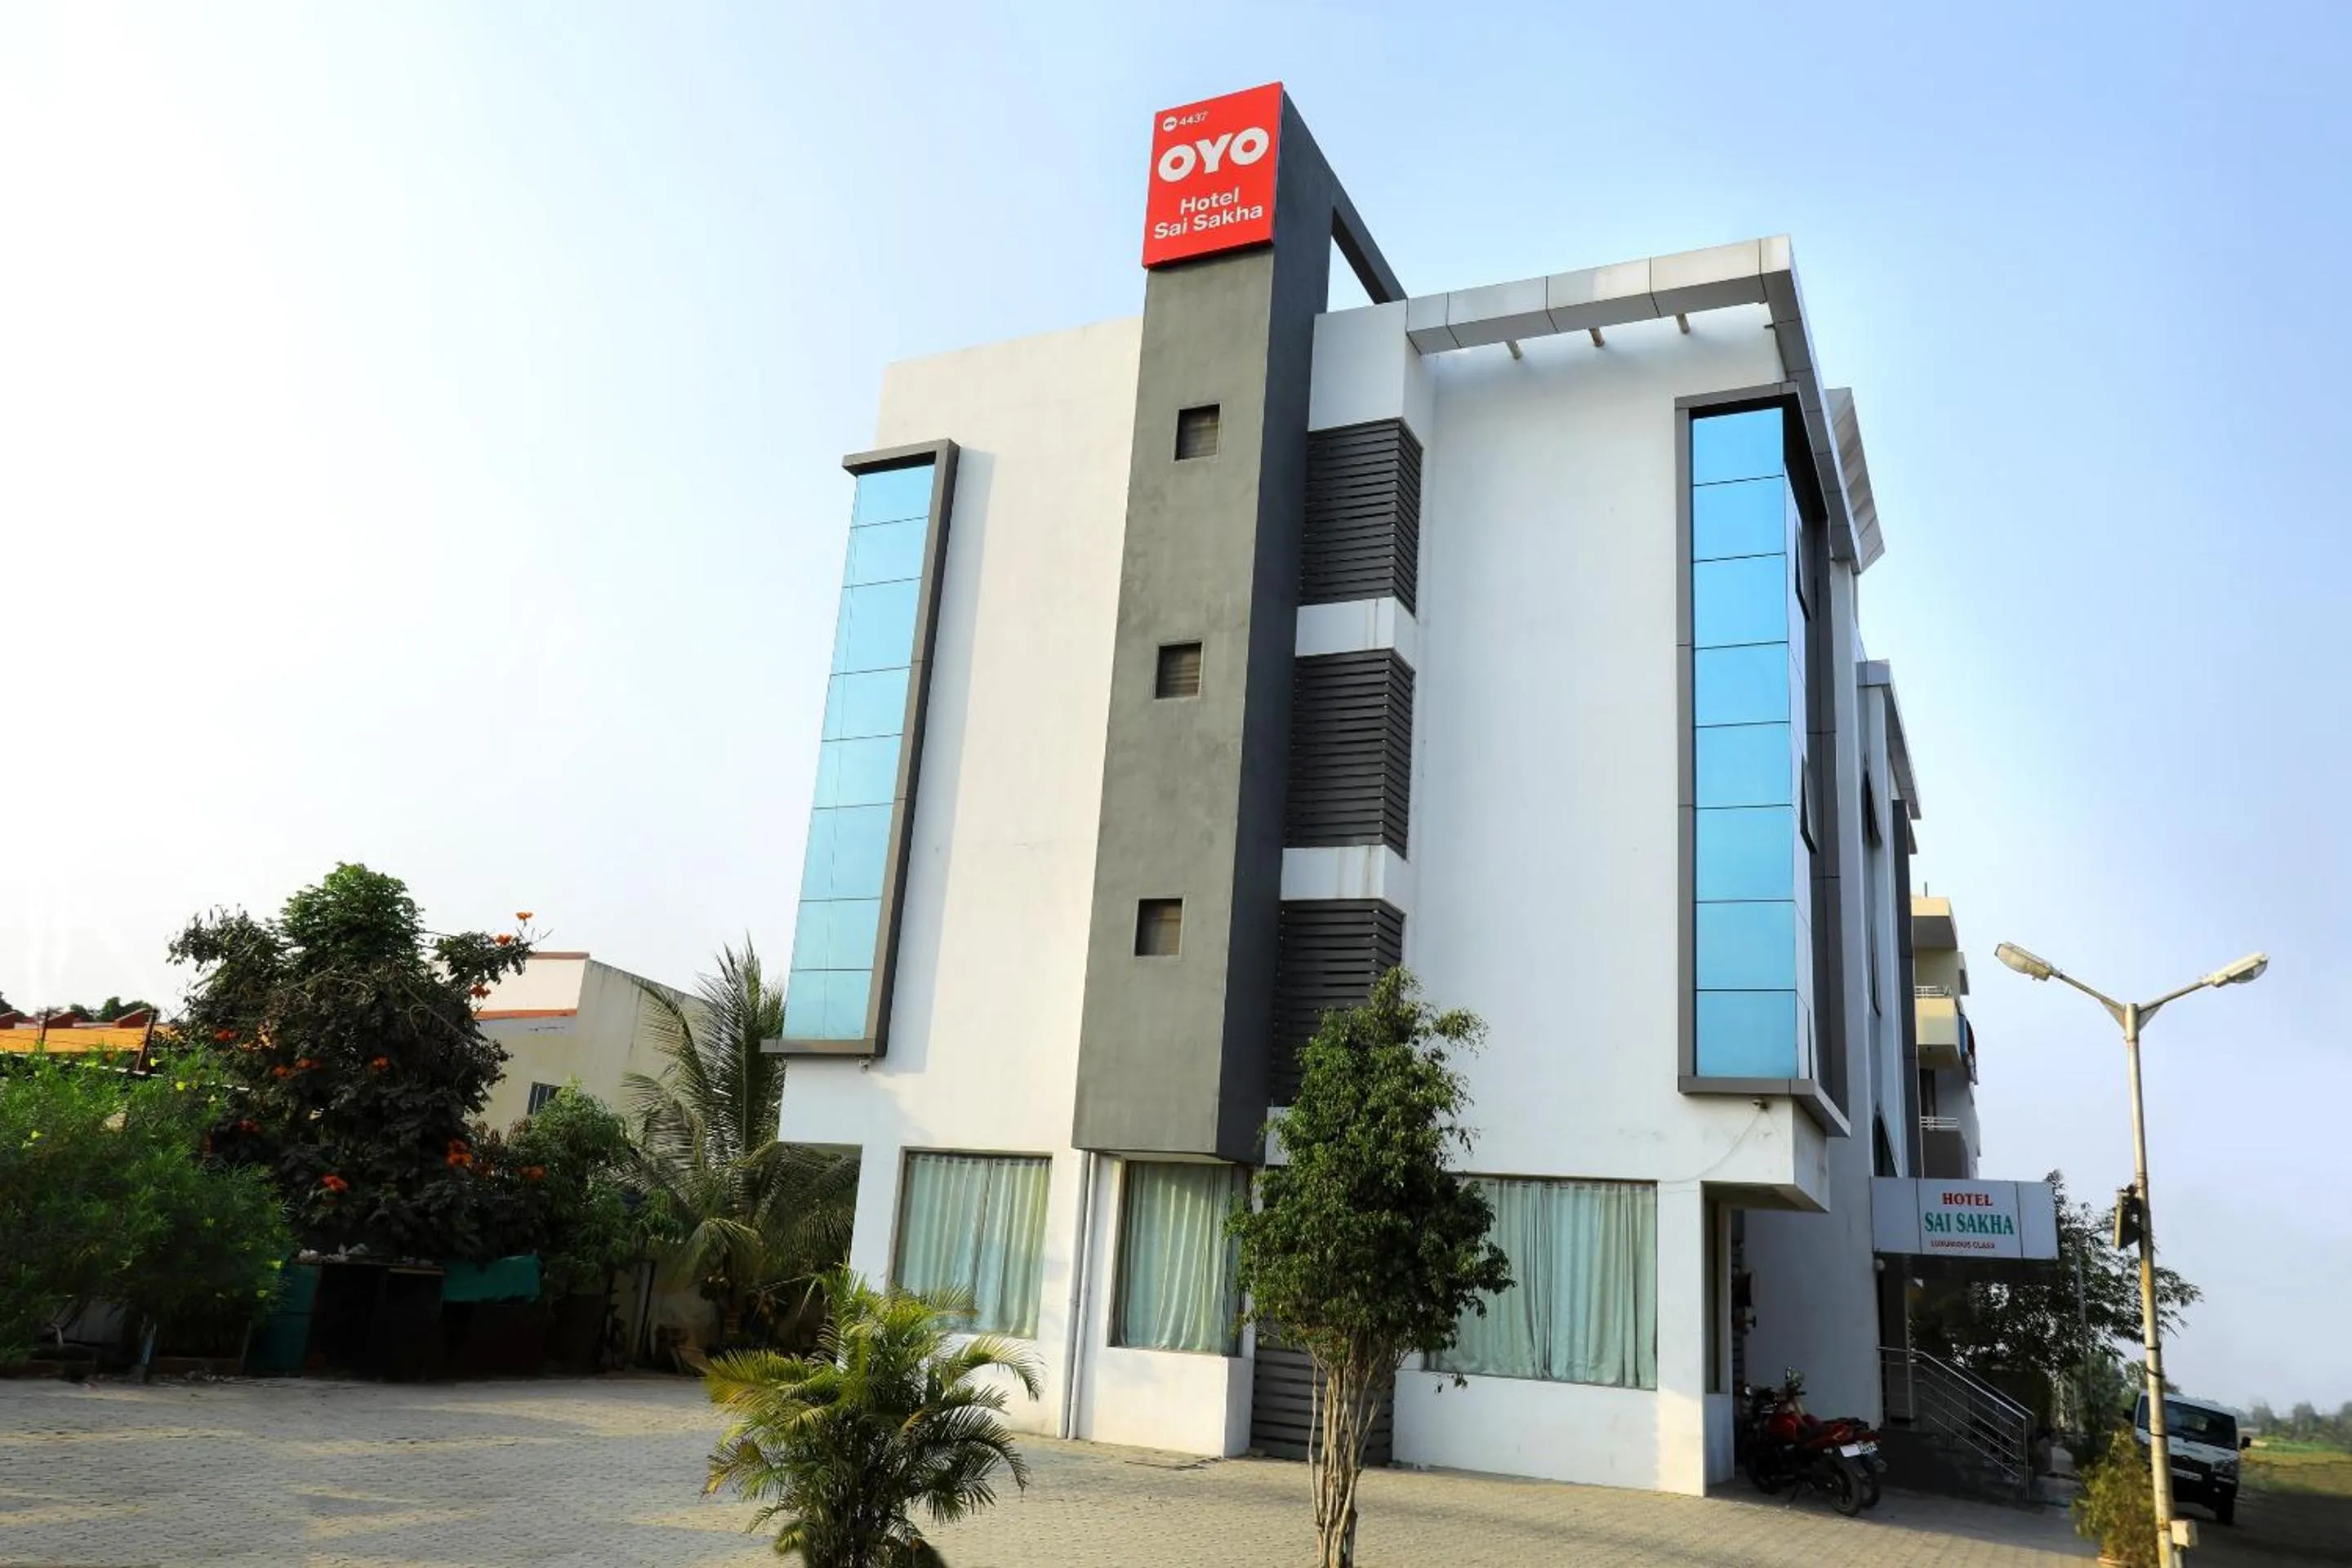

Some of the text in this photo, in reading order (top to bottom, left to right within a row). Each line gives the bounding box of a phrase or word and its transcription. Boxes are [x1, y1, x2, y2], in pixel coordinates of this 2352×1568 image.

[1158, 127, 1269, 182] OYO
[1180, 186, 1240, 215] Hotel
[1154, 205, 1263, 238] Sai Sakha
[1942, 1192, 1993, 1206] HOTEL
[1924, 1212, 2014, 1235] SAI SAKHA
